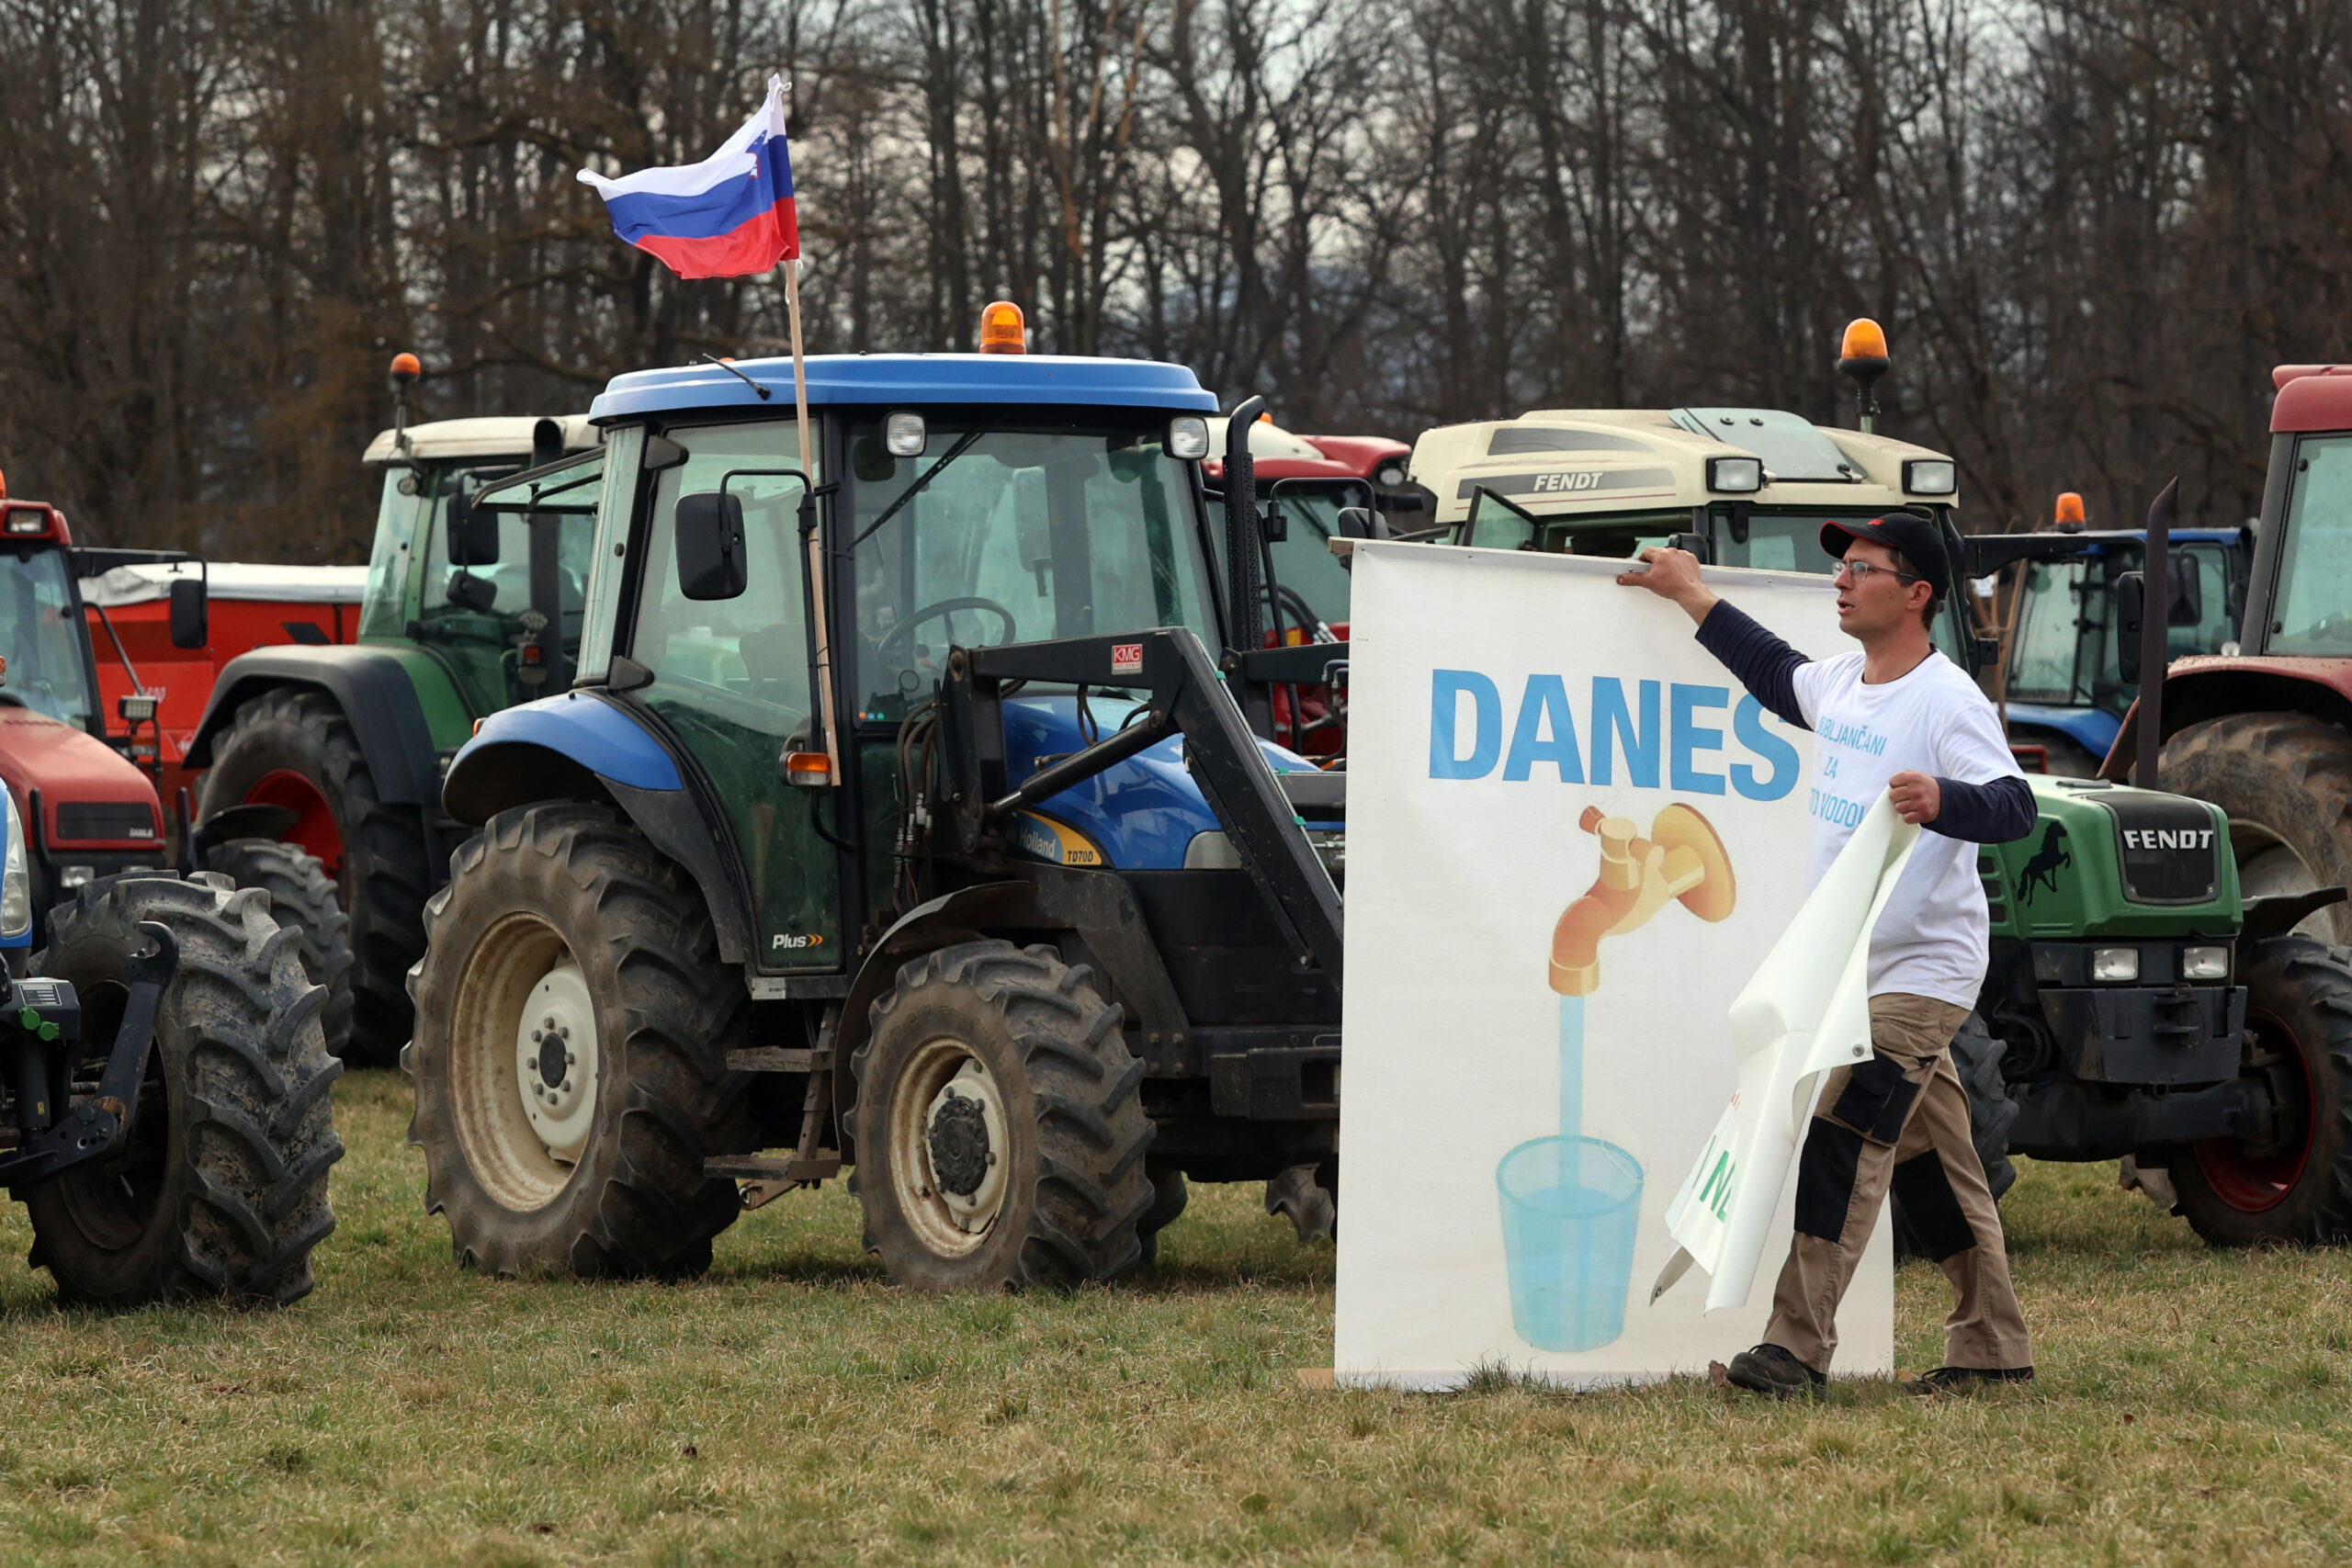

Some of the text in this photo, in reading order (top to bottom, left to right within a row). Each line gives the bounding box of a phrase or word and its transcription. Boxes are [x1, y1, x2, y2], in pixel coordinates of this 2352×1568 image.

[1533, 471, 1604, 492] FENDT
[1114, 647, 1141, 662] KMG
[1430, 669, 1801, 802] DANES
[1824, 755, 1839, 778] ZA
[1020, 825, 1057, 859] Holland
[2123, 829, 2214, 850] FENDT
[1068, 850, 1094, 863] TD70D
[773, 933, 808, 949] Plus
